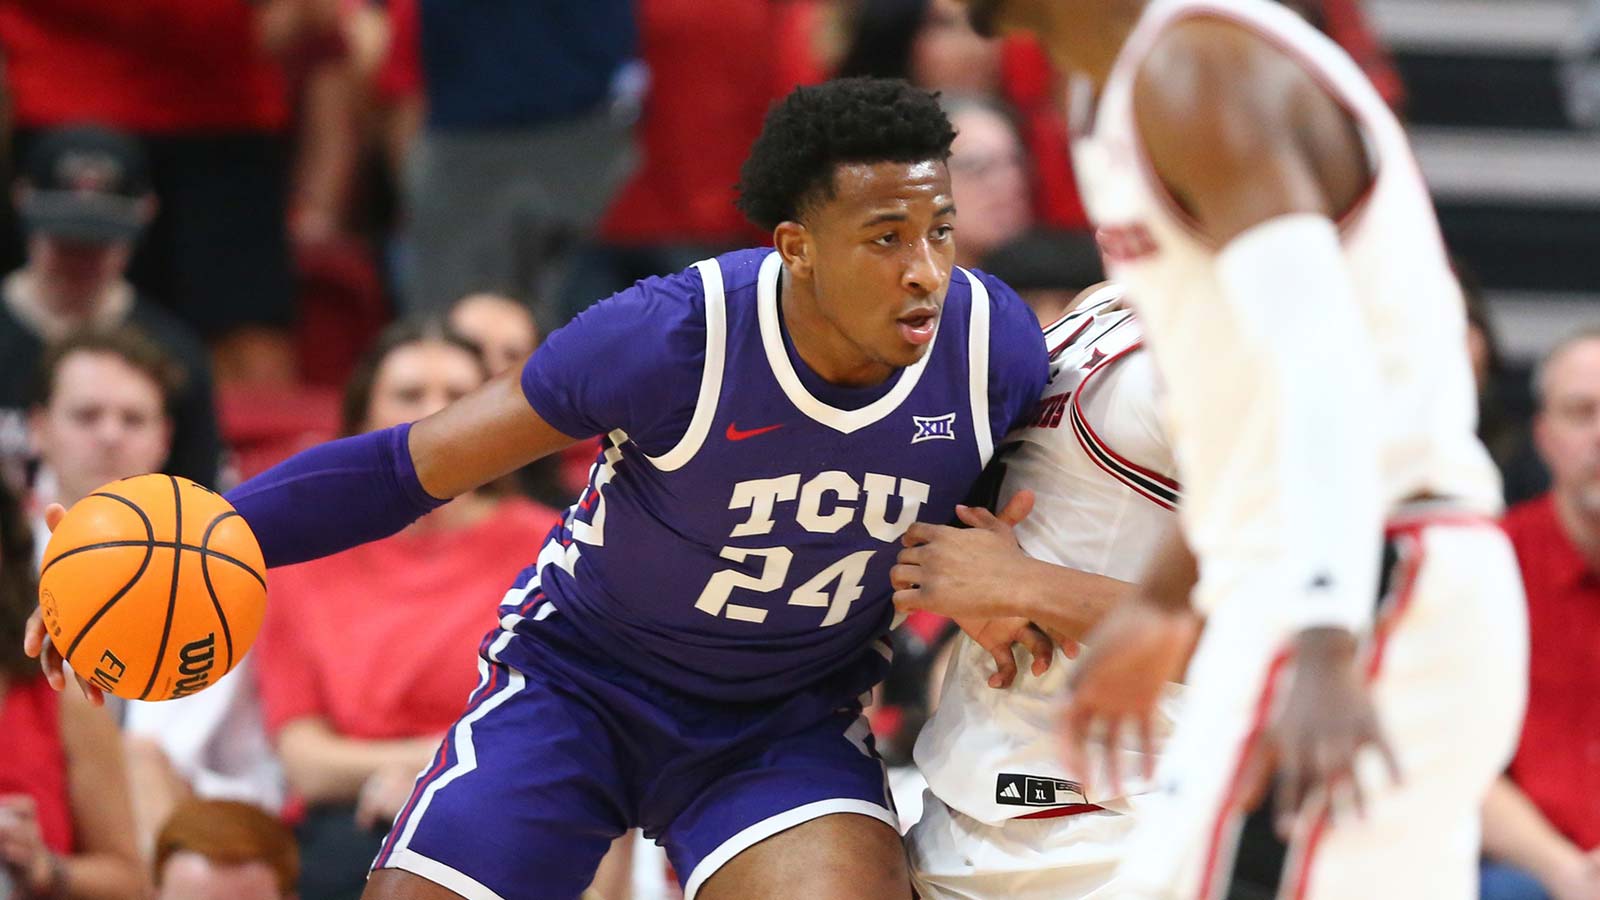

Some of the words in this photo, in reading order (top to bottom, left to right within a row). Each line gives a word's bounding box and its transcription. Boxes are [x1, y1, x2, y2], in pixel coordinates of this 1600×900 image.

[728, 470, 930, 543] TCU
[694, 545, 877, 627] 24
[1035, 789, 1047, 800] XL
